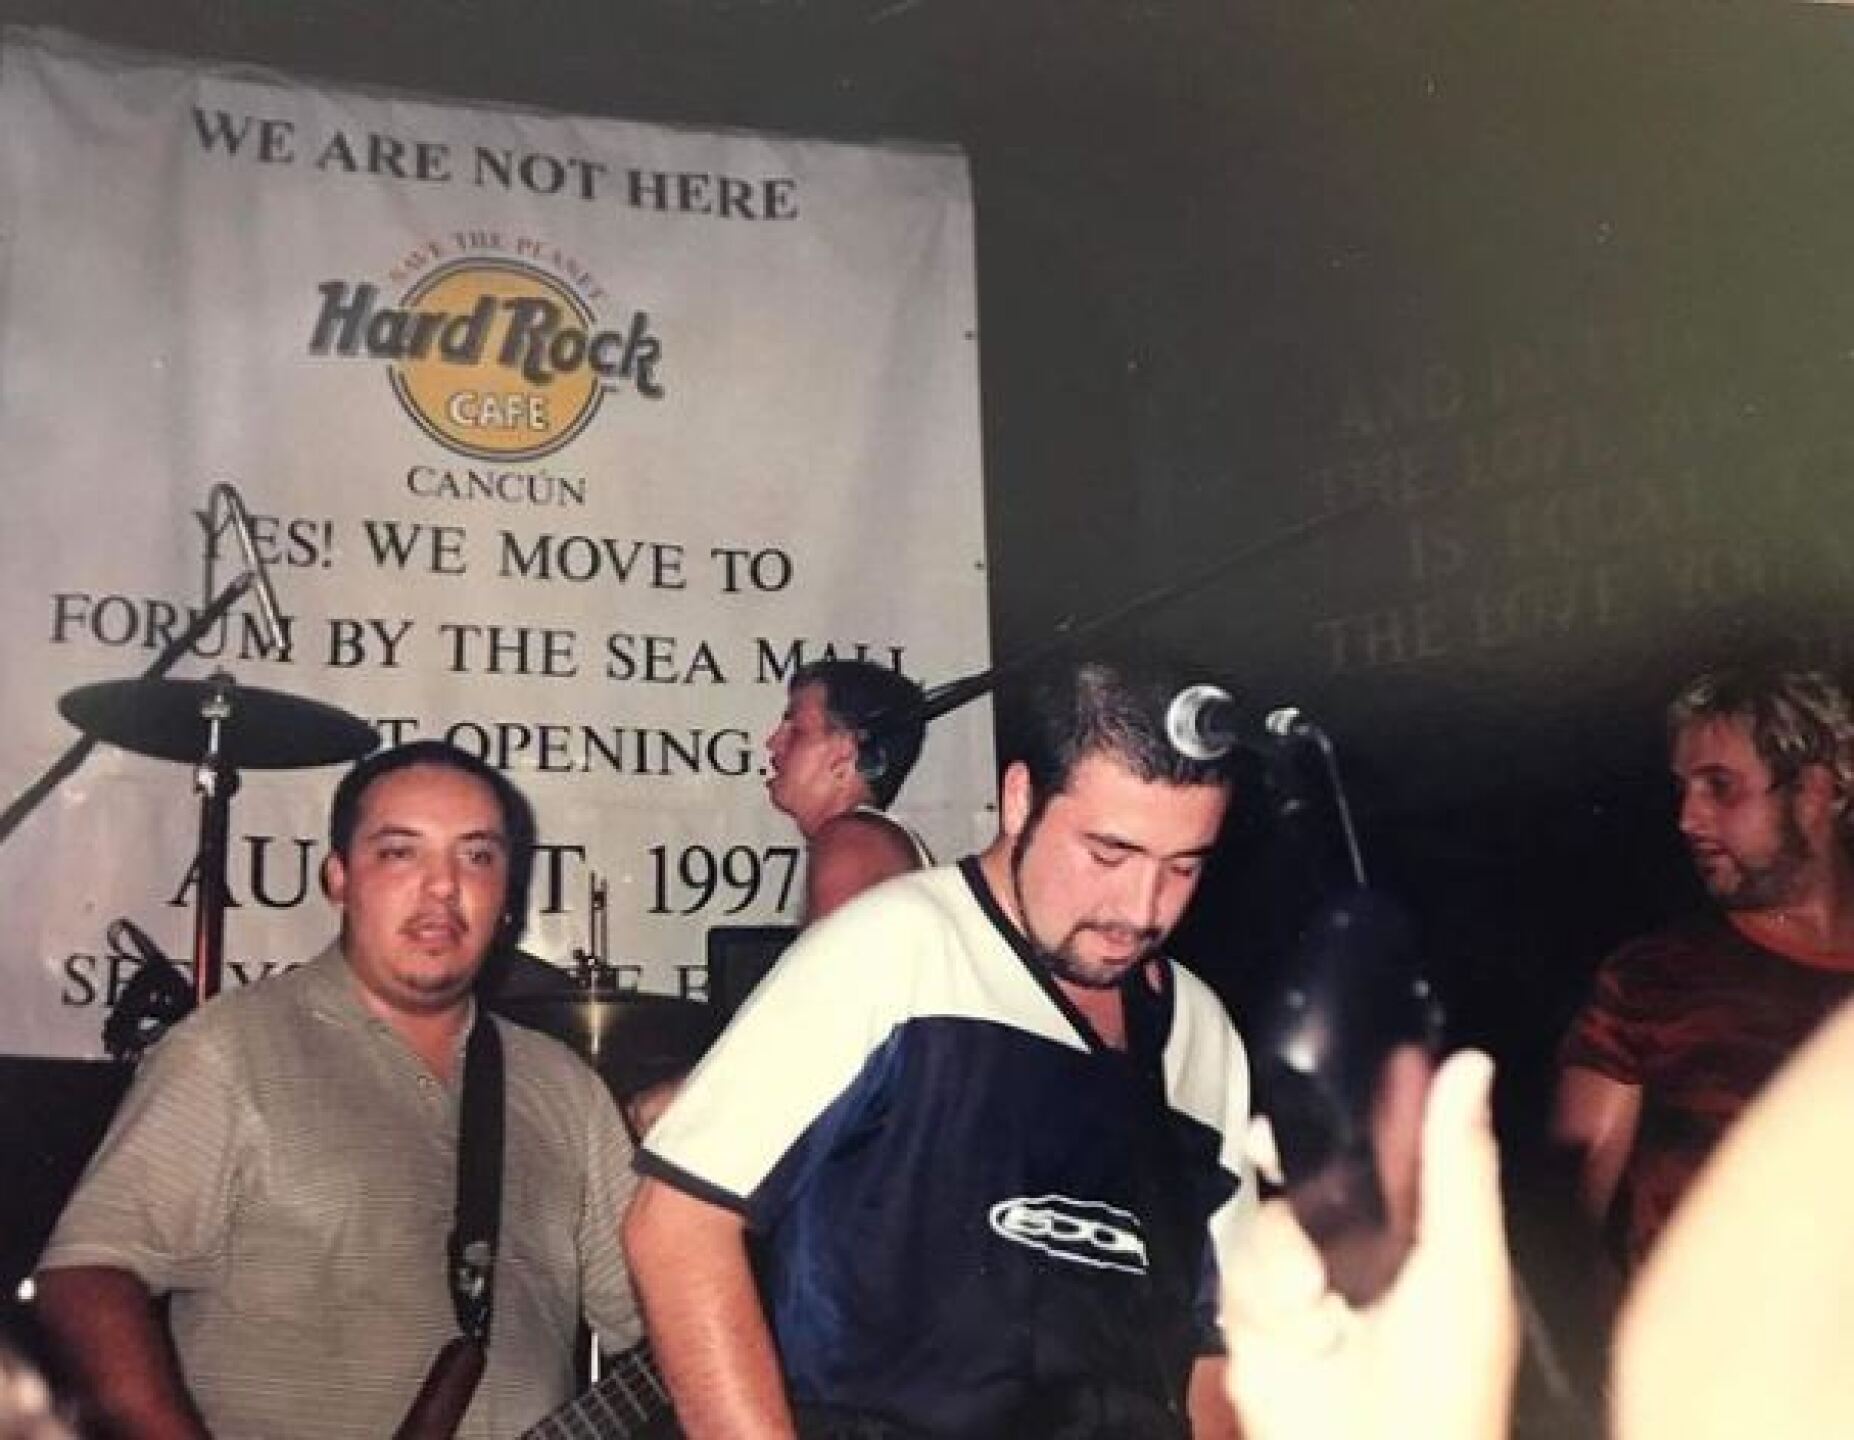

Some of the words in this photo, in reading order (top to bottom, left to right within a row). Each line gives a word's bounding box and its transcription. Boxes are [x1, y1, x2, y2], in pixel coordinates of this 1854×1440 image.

[193, 106, 295, 165] WE
[316, 132, 451, 182] ARE
[474, 146, 605, 201] NOT
[627, 169, 799, 221] HERE
[308, 280, 497, 366] Hard
[499, 295, 664, 399] Rock
[448, 393, 551, 432] CAFE
[192, 511, 334, 569] YES!
[364, 520, 467, 575] WE
[497, 530, 687, 590] MOVE
[710, 548, 793, 593] TO
[49, 593, 295, 664] FORUM
[328, 618, 414, 669] BY
[440, 624, 577, 679] THE
[606, 632, 728, 684] SEA
[444, 720, 768, 776] OPENING.
[648, 845, 799, 916] 1997
